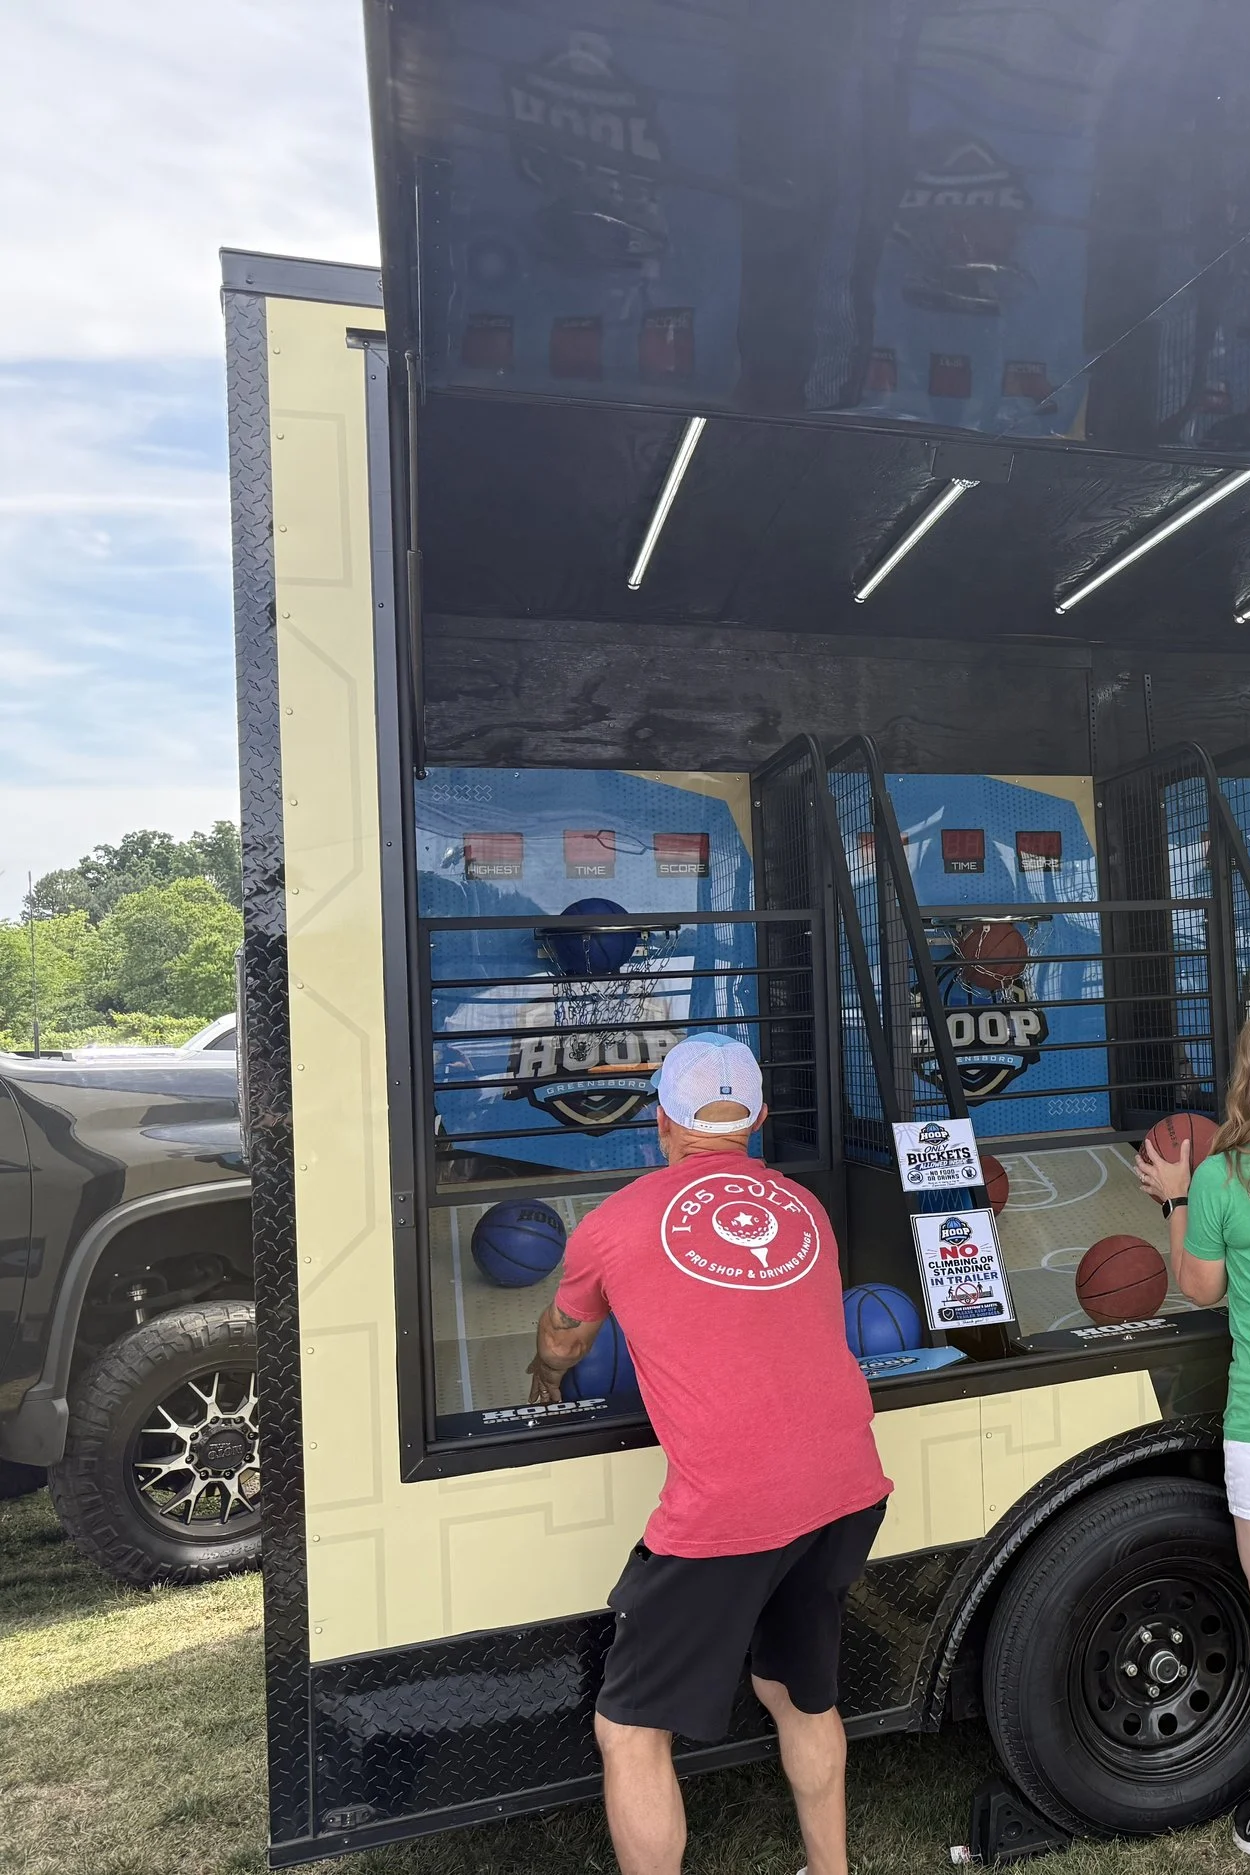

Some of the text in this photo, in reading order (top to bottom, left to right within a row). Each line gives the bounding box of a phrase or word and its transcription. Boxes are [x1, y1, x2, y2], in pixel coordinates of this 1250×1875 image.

[468, 864, 521, 875] HIGHEST
[575, 865, 606, 875] TIME
[660, 863, 706, 873] SCORE
[951, 861, 978, 871] TIME
[516, 1030, 679, 1078] HOOP
[546, 1079, 647, 1096] GREENSBORO
[920, 1130, 948, 1141] HOOP
[924, 1143, 949, 1154] ONLY
[907, 1147, 971, 1166] BUCKETS
[672, 1189, 715, 1233] I-85
[941, 1227, 970, 1239] HOOP
[685, 1231, 812, 1279] PRO SHOP & DRIVING RANGE
[940, 1244, 979, 1260] NO
[928, 1255, 994, 1269] CLIMBING OR
[933, 1263, 991, 1277] STANDING
[930, 1271, 999, 1286] IN TRAILER
[1070, 1318, 1167, 1337] HOOP
[482, 1398, 606, 1421] HOOP
